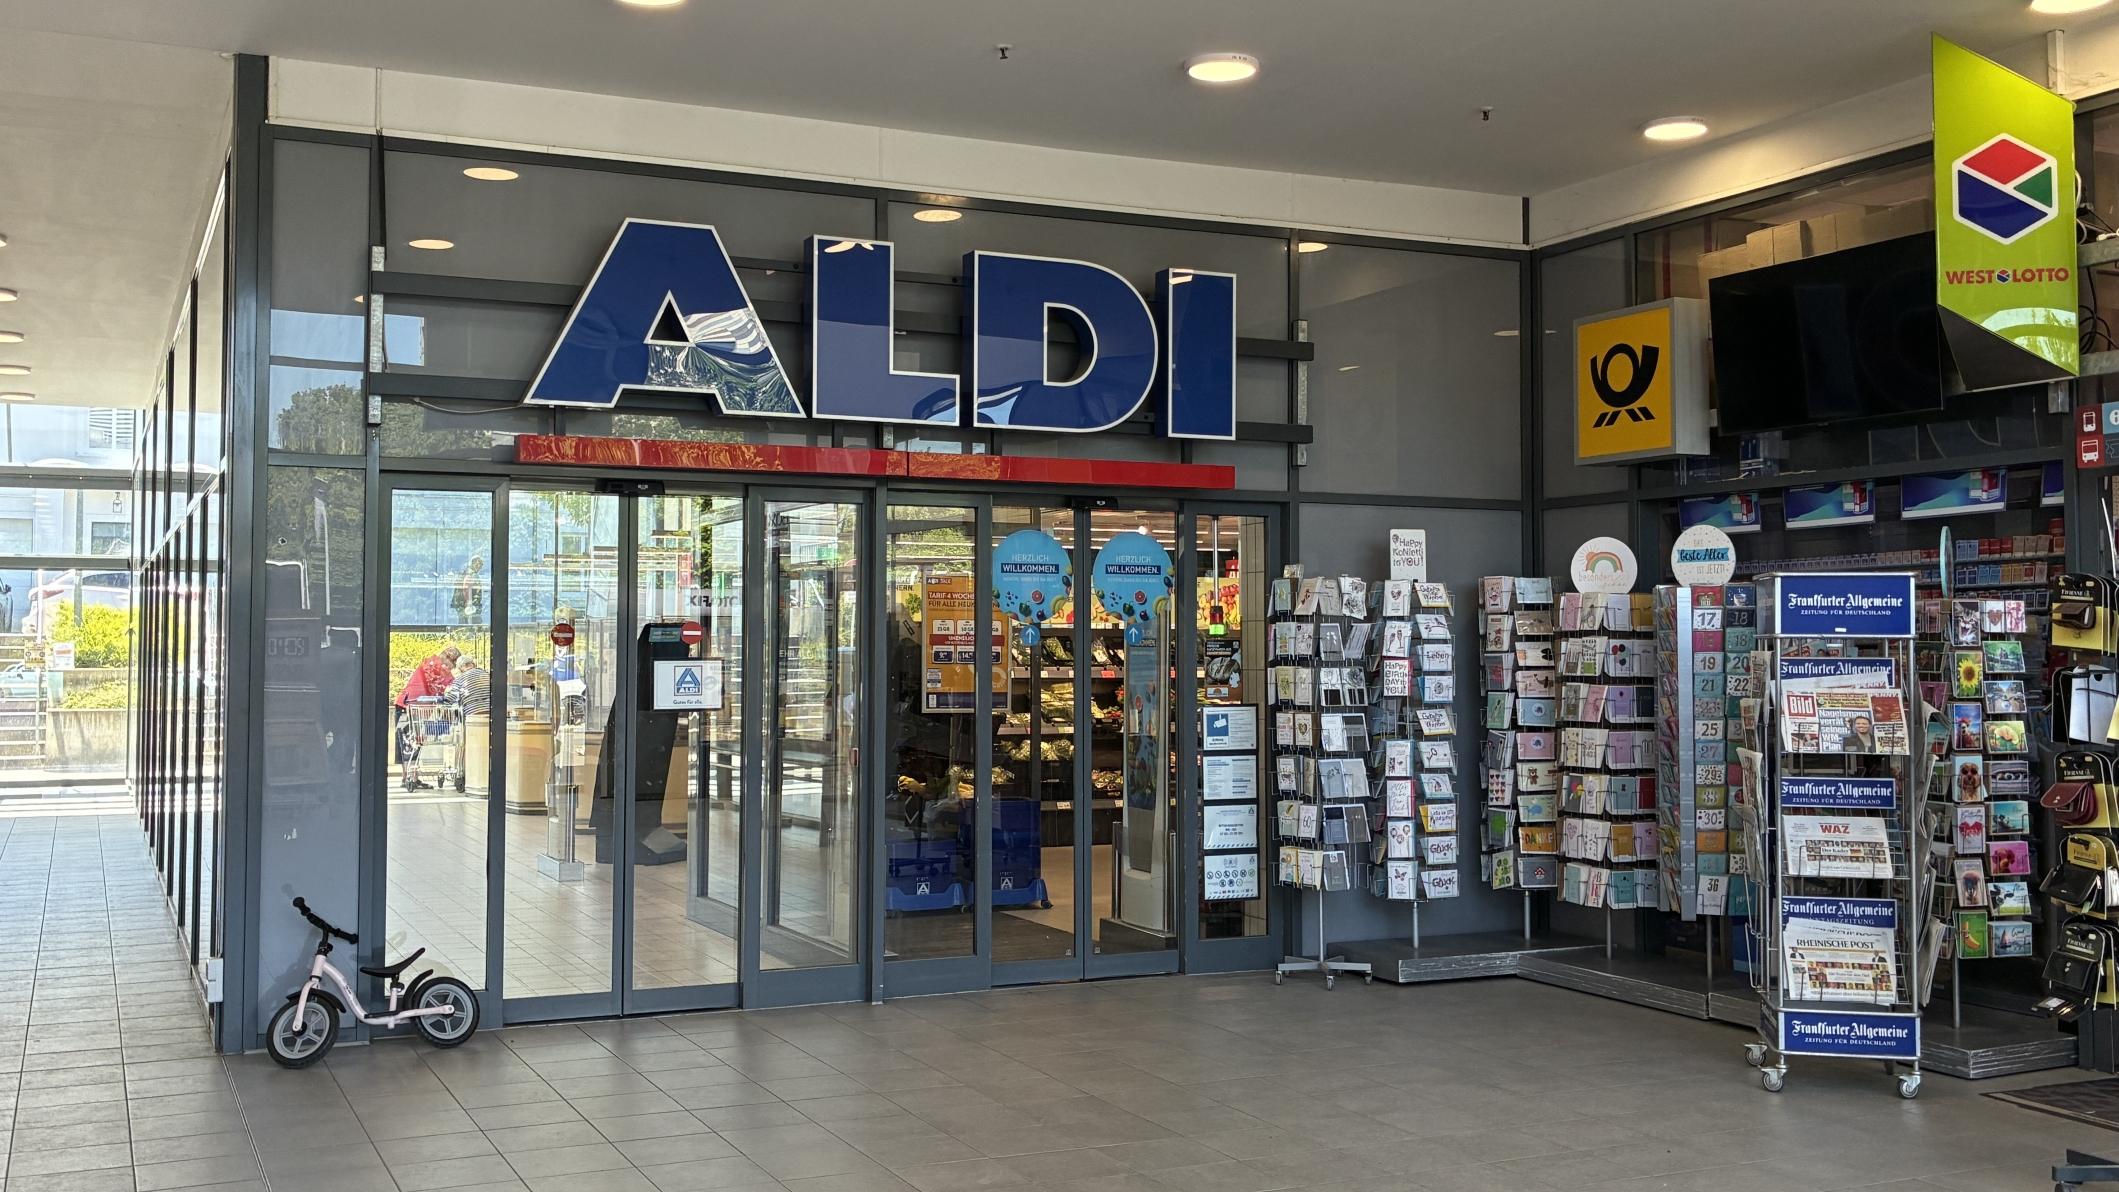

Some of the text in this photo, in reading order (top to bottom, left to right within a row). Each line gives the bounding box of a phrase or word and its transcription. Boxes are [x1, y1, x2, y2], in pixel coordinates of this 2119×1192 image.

[1945, 267, 2070, 284] WEST LOTTO
[522, 216, 1238, 441] ALDI
[1011, 553, 1049, 562] HERZLICH
[1115, 555, 1151, 563] HERZLICH
[1002, 563, 1058, 573] WILLKOMMEN.
[1107, 566, 1159, 574] WILLKOMMEN.
[1788, 593, 1903, 609] Frankfurter Allgemeine
[1698, 612, 1717, 627] 17
[1733, 612, 1748, 625] 18
[1700, 656, 1716, 670] 19
[1732, 656, 1750, 671] 20
[1781, 662, 1891, 677] Frankfurter Allgemeine
[679, 686, 699, 694] ALDI
[1702, 679, 1715, 692] 21
[1733, 678, 1750, 692] 22
[1789, 696, 1814, 714] Bild
[1818, 710, 1869, 719] Nagelsmann
[1701, 723, 1719, 737] 25
[1734, 723, 1742, 736] 2
[1822, 734, 1843, 742] WM-
[1700, 745, 1719, 759] 27
[1823, 742, 1841, 751] Plan
[1704, 769, 1718, 781] 29
[1781, 781, 1892, 798] Frankfurter Allgemeine
[1704, 812, 1718, 826] 30
[1820, 825, 1850, 834] WAZ
[1707, 878, 1720, 892] 36
[1782, 900, 1893, 917] Frankfurter Allgemeine
[1796, 939, 1875, 949] RHEINISCHE POST
[1791, 1020, 1908, 1038] Frankfurter Allgemeine
